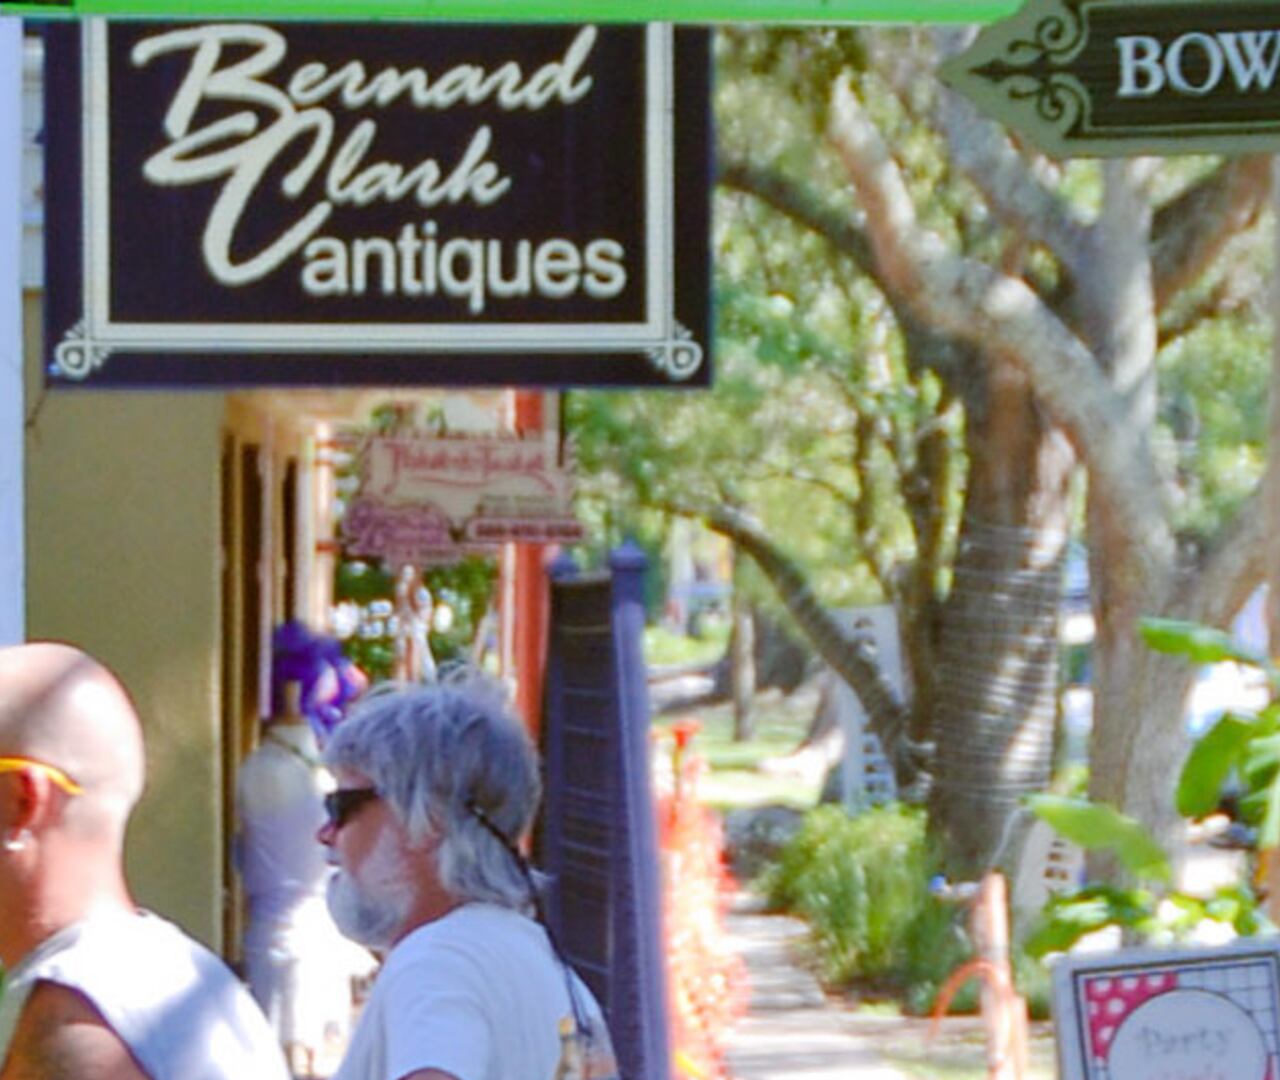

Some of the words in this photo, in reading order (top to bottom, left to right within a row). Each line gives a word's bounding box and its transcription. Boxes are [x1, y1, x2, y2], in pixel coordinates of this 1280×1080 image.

[130, 23, 598, 138] Bernard
[143, 107, 513, 286] Clark
[301, 218, 628, 314] antiques
